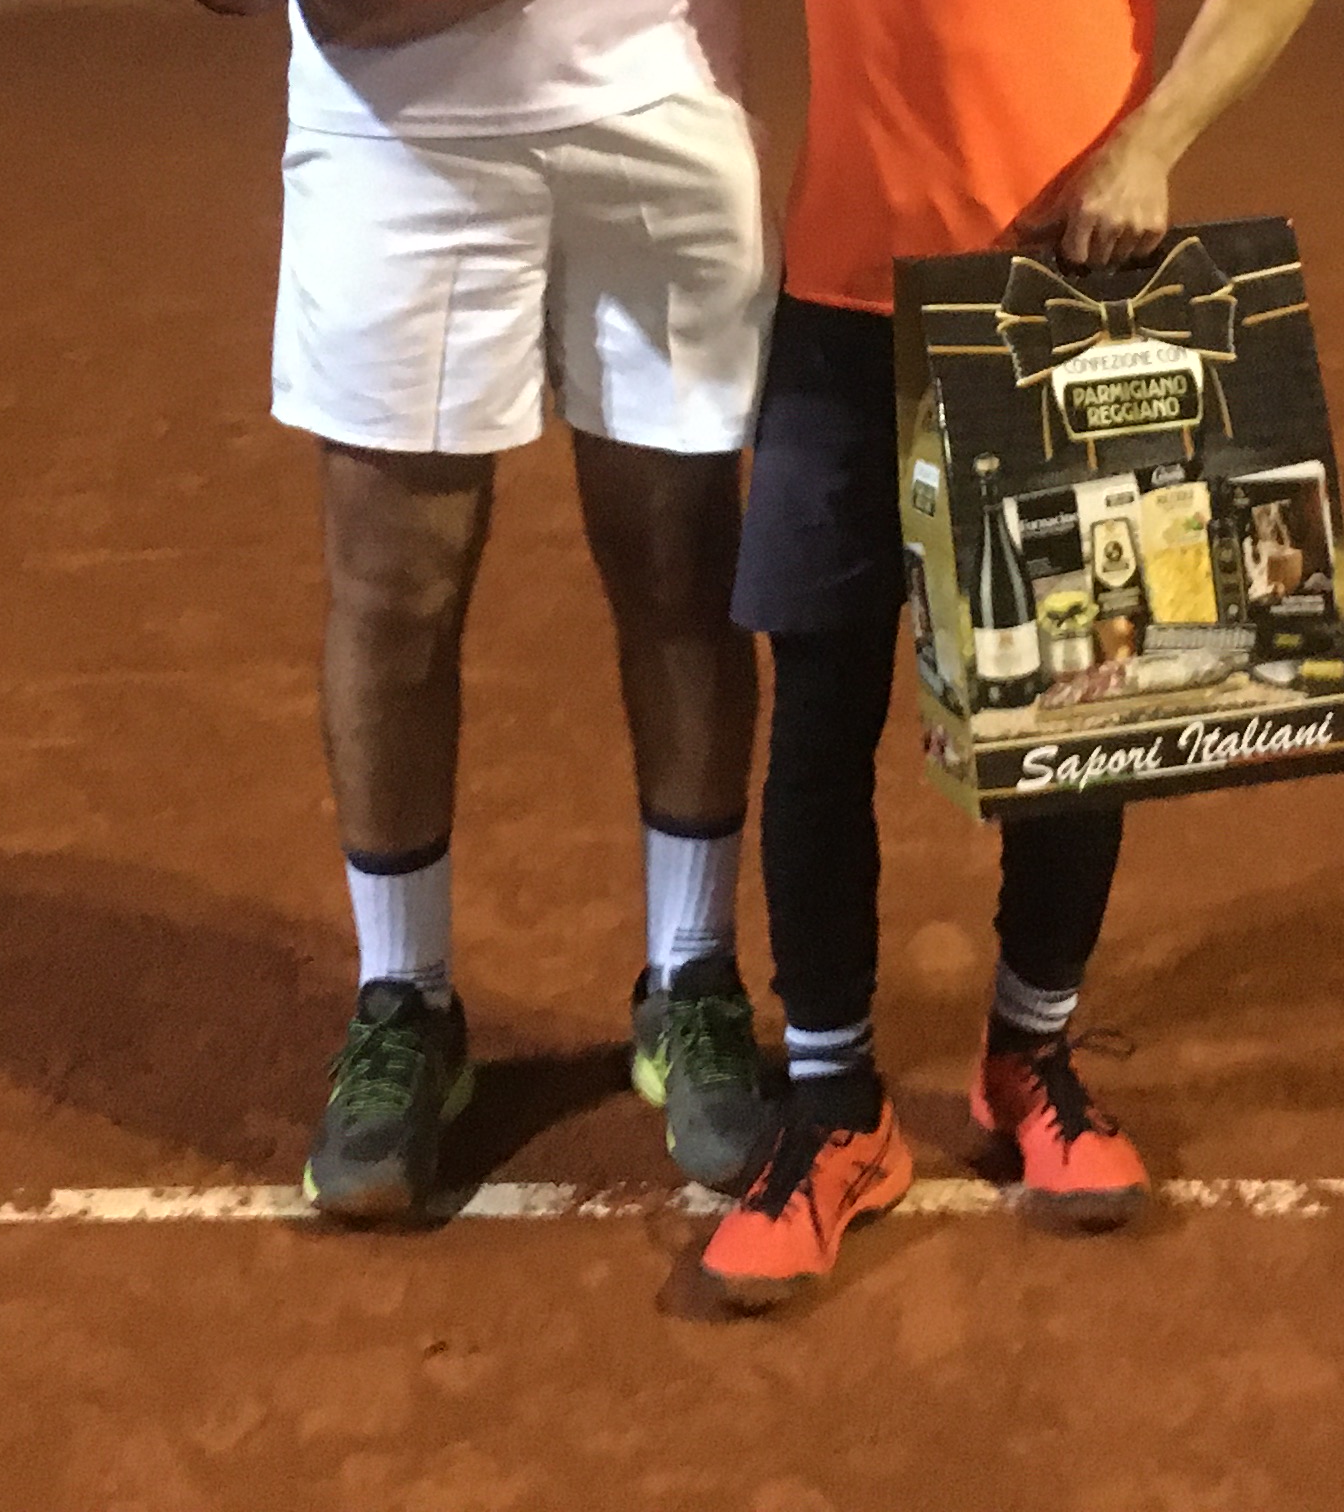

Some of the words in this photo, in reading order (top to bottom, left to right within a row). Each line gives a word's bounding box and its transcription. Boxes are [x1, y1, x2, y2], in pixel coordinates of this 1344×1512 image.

[1064, 349, 1153, 375] CONFEZIONE
[1156, 345, 1188, 364] CON
[1071, 374, 1189, 408] PARMIGIANO
[1085, 395, 1181, 429] REGGIANO
[1015, 735, 1164, 794] Sapori
[1176, 711, 1335, 766] Italiani
